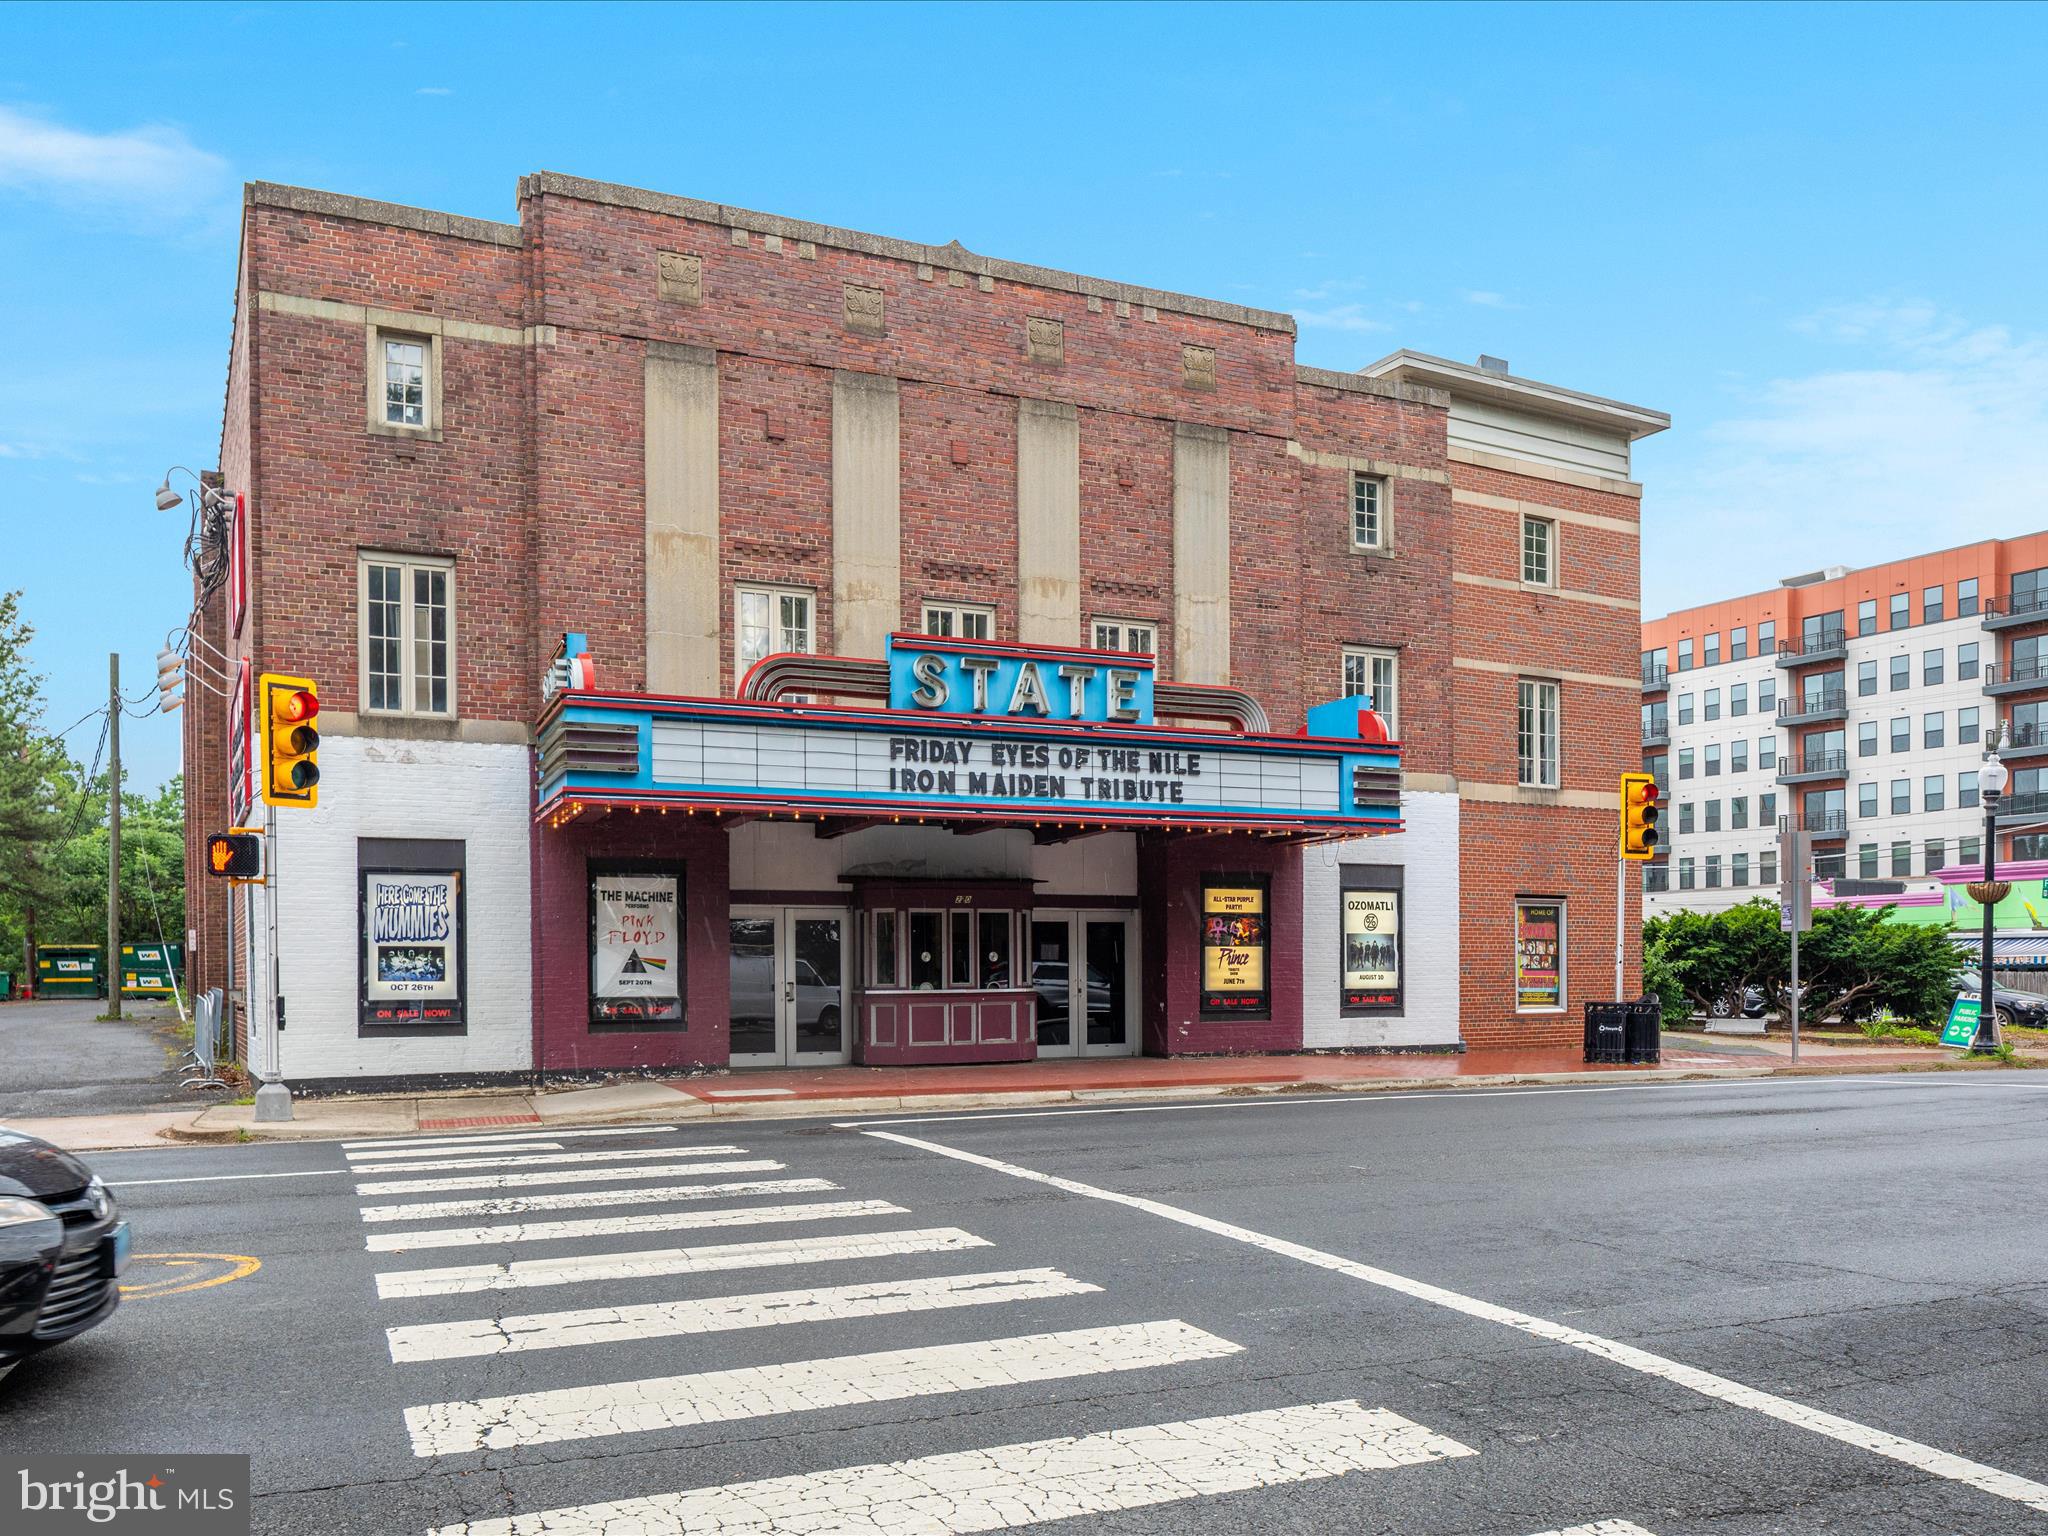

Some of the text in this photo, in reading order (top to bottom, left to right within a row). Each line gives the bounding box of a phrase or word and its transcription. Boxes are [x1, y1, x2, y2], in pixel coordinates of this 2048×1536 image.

[911, 653, 1142, 721] STATE
[889, 737, 1201, 776] FRIDAY EYES OF THE NILE
[889, 768, 1184, 803] IRON MAIDEN TRIBUTE
[377, 884, 447, 907] HERE COME THE
[600, 890, 673, 903] THE MACHINE
[1348, 901, 1394, 911] OZOMATLI
[374, 904, 449, 943] MUMMIES
[621, 914, 655, 928] PINK
[608, 930, 665, 945] FLOYD
[1218, 948, 1250, 970] Prince
[376, 1009, 451, 1018] ON SALE NOW!
